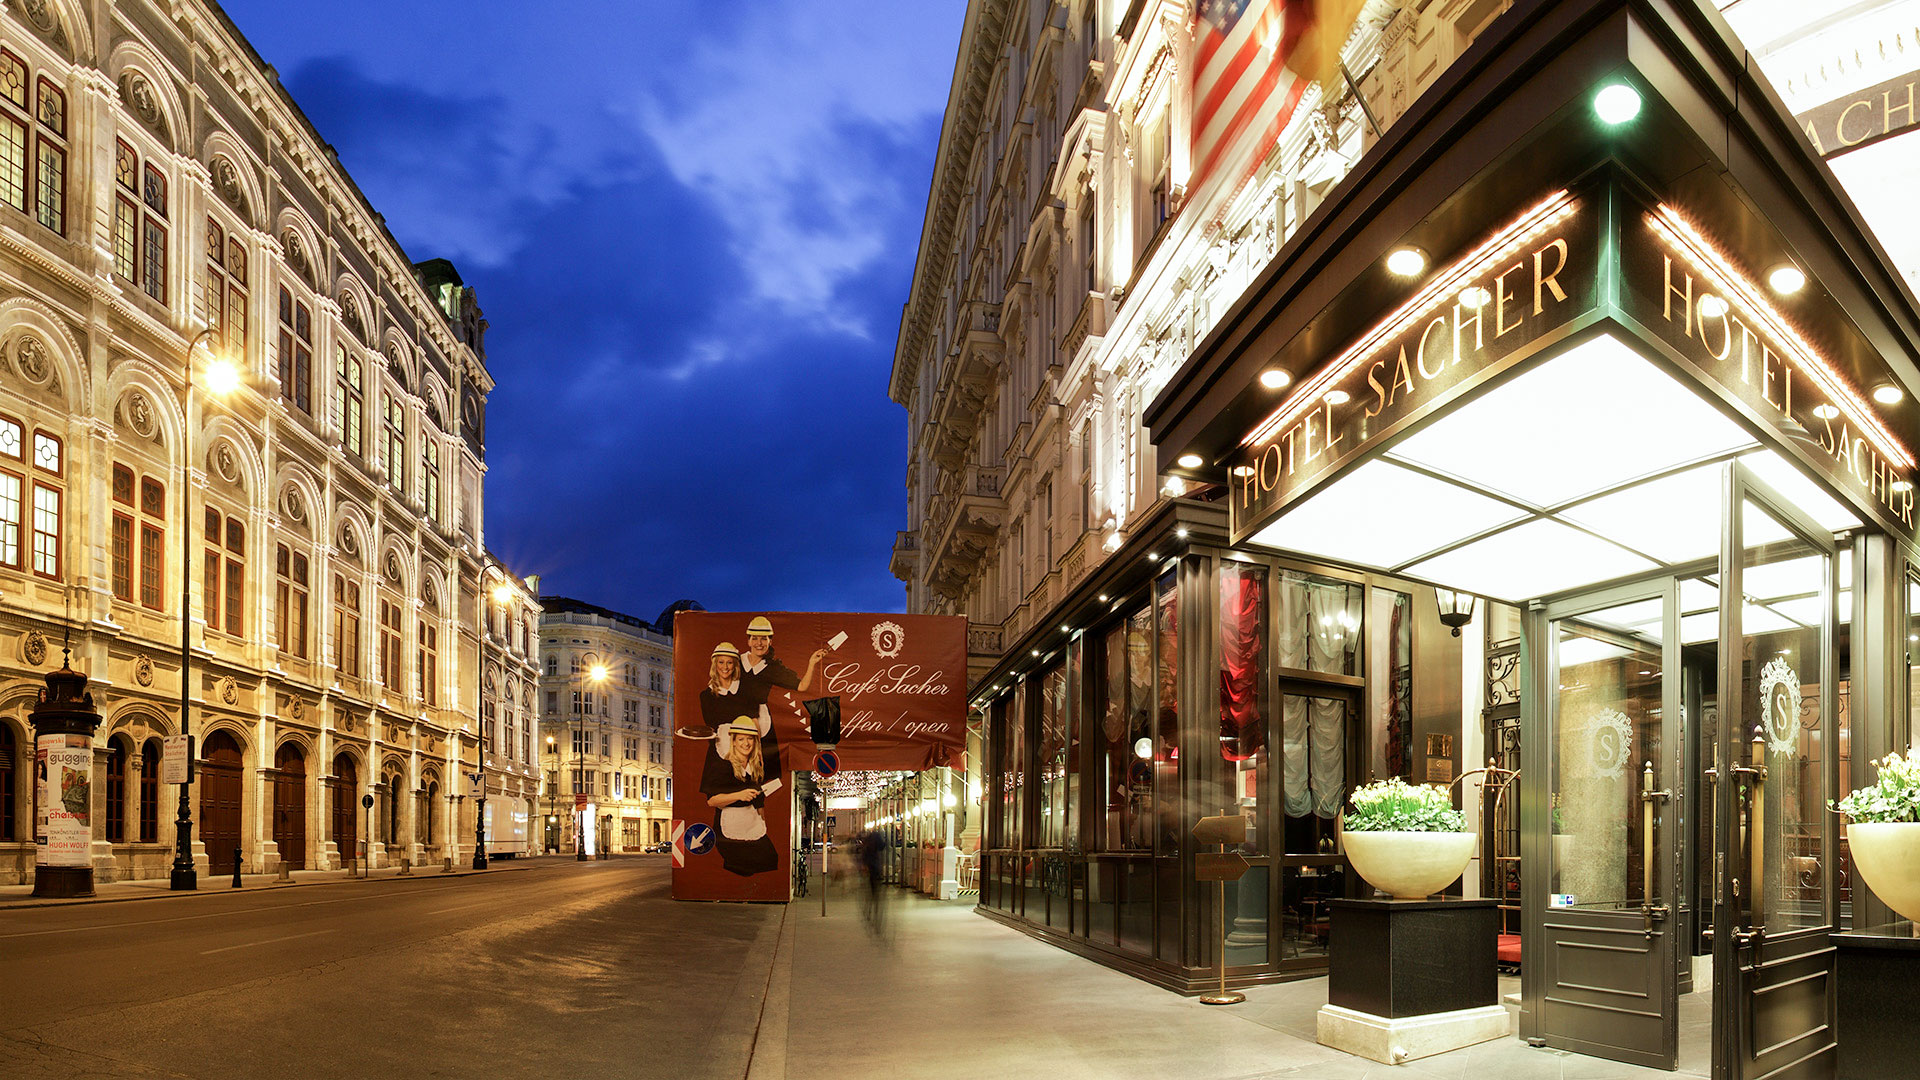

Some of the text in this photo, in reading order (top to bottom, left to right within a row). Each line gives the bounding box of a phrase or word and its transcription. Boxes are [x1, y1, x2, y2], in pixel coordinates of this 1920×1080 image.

[1241, 237, 1570, 510] HOTEL SACHER
[1661, 254, 1915, 531] HOTEL SACHER
[882, 634, 893, 649] S
[823, 662, 950, 702] Café Sacher
[840, 710, 884, 739] ffen
[904, 721, 950, 739] open
[49, 841, 68, 849] HUGH
